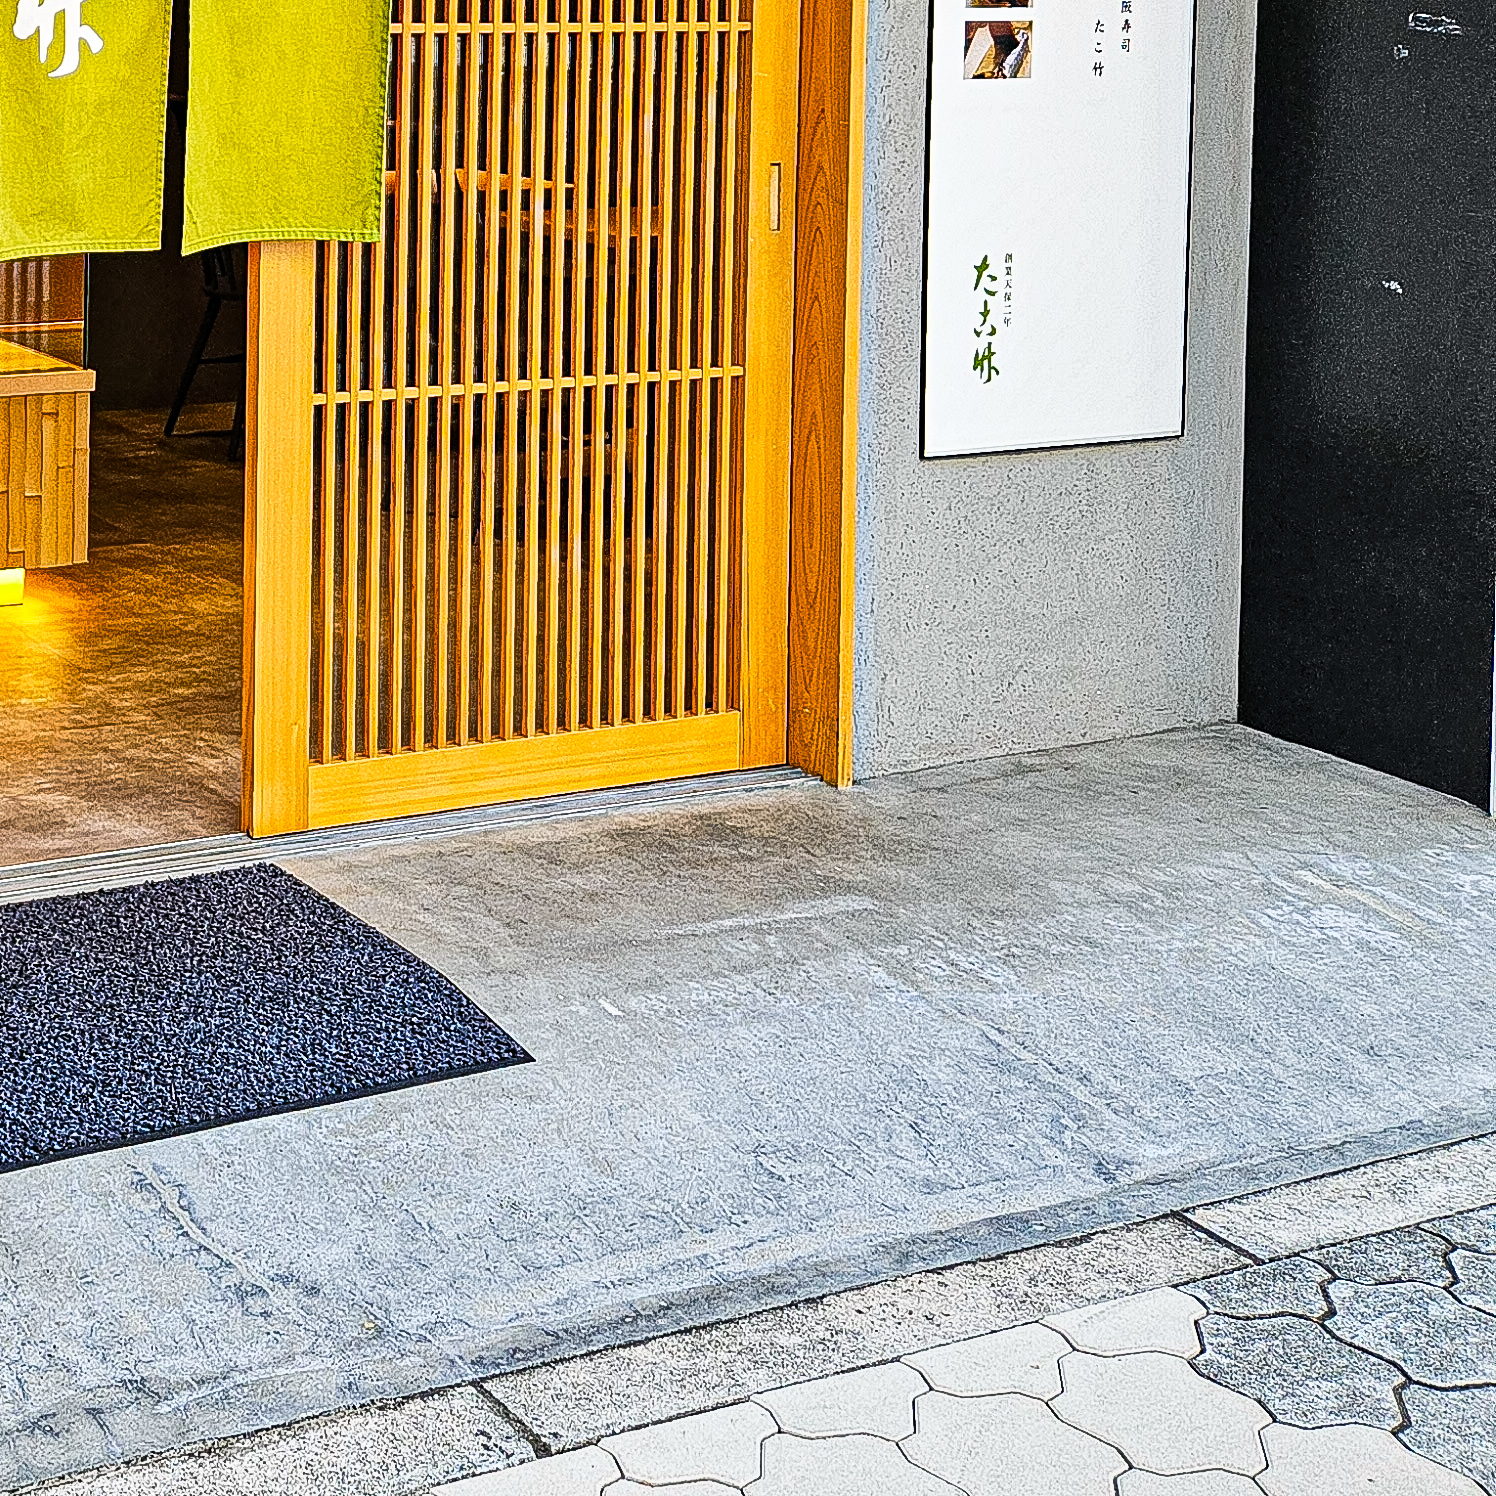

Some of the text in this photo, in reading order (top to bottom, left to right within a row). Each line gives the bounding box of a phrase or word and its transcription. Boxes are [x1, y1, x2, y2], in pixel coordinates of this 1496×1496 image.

[1092, 18, 1105, 77] たこ竹
[1003, 252, 1013, 327] 創業天保二年
